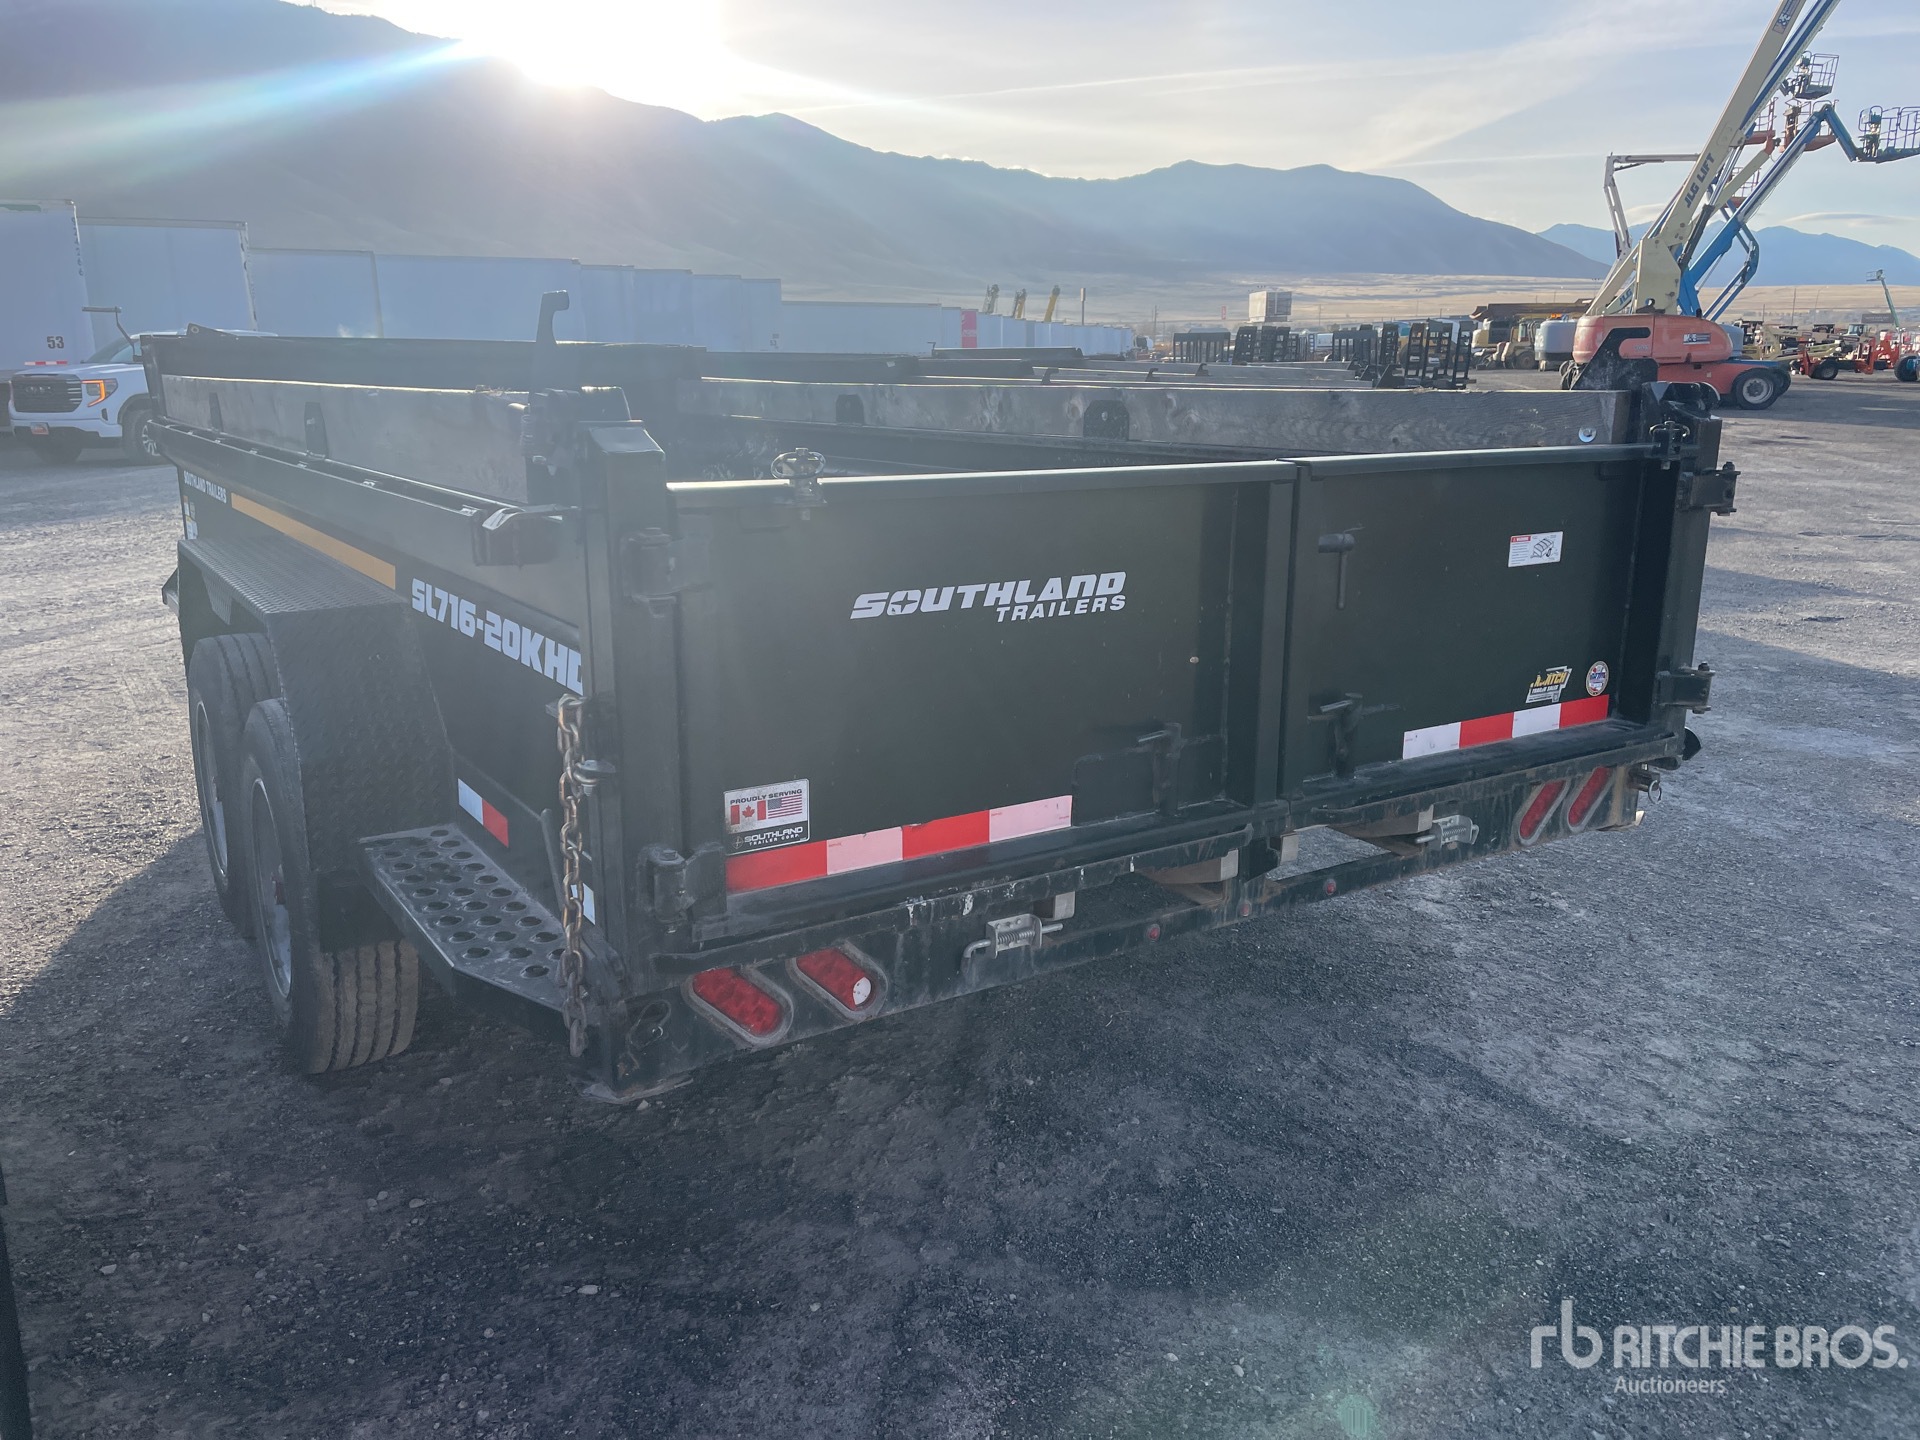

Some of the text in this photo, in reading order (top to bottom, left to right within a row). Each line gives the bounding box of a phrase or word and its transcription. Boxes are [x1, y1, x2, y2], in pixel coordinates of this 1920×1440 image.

[1684, 152, 1715, 208] JLG LIFT
[1619, 288, 1633, 306] JLG
[46, 336, 65, 349] 53
[183, 470, 227, 504] SOUTHLAND TRAILERS
[849, 571, 1127, 620] SOUTHLAND
[996, 594, 1127, 623] TRAILERS
[730, 789, 803, 804] PROUDLY SERVING
[744, 826, 803, 843] SOUTHLAND
[749, 837, 778, 846] TRAILER
